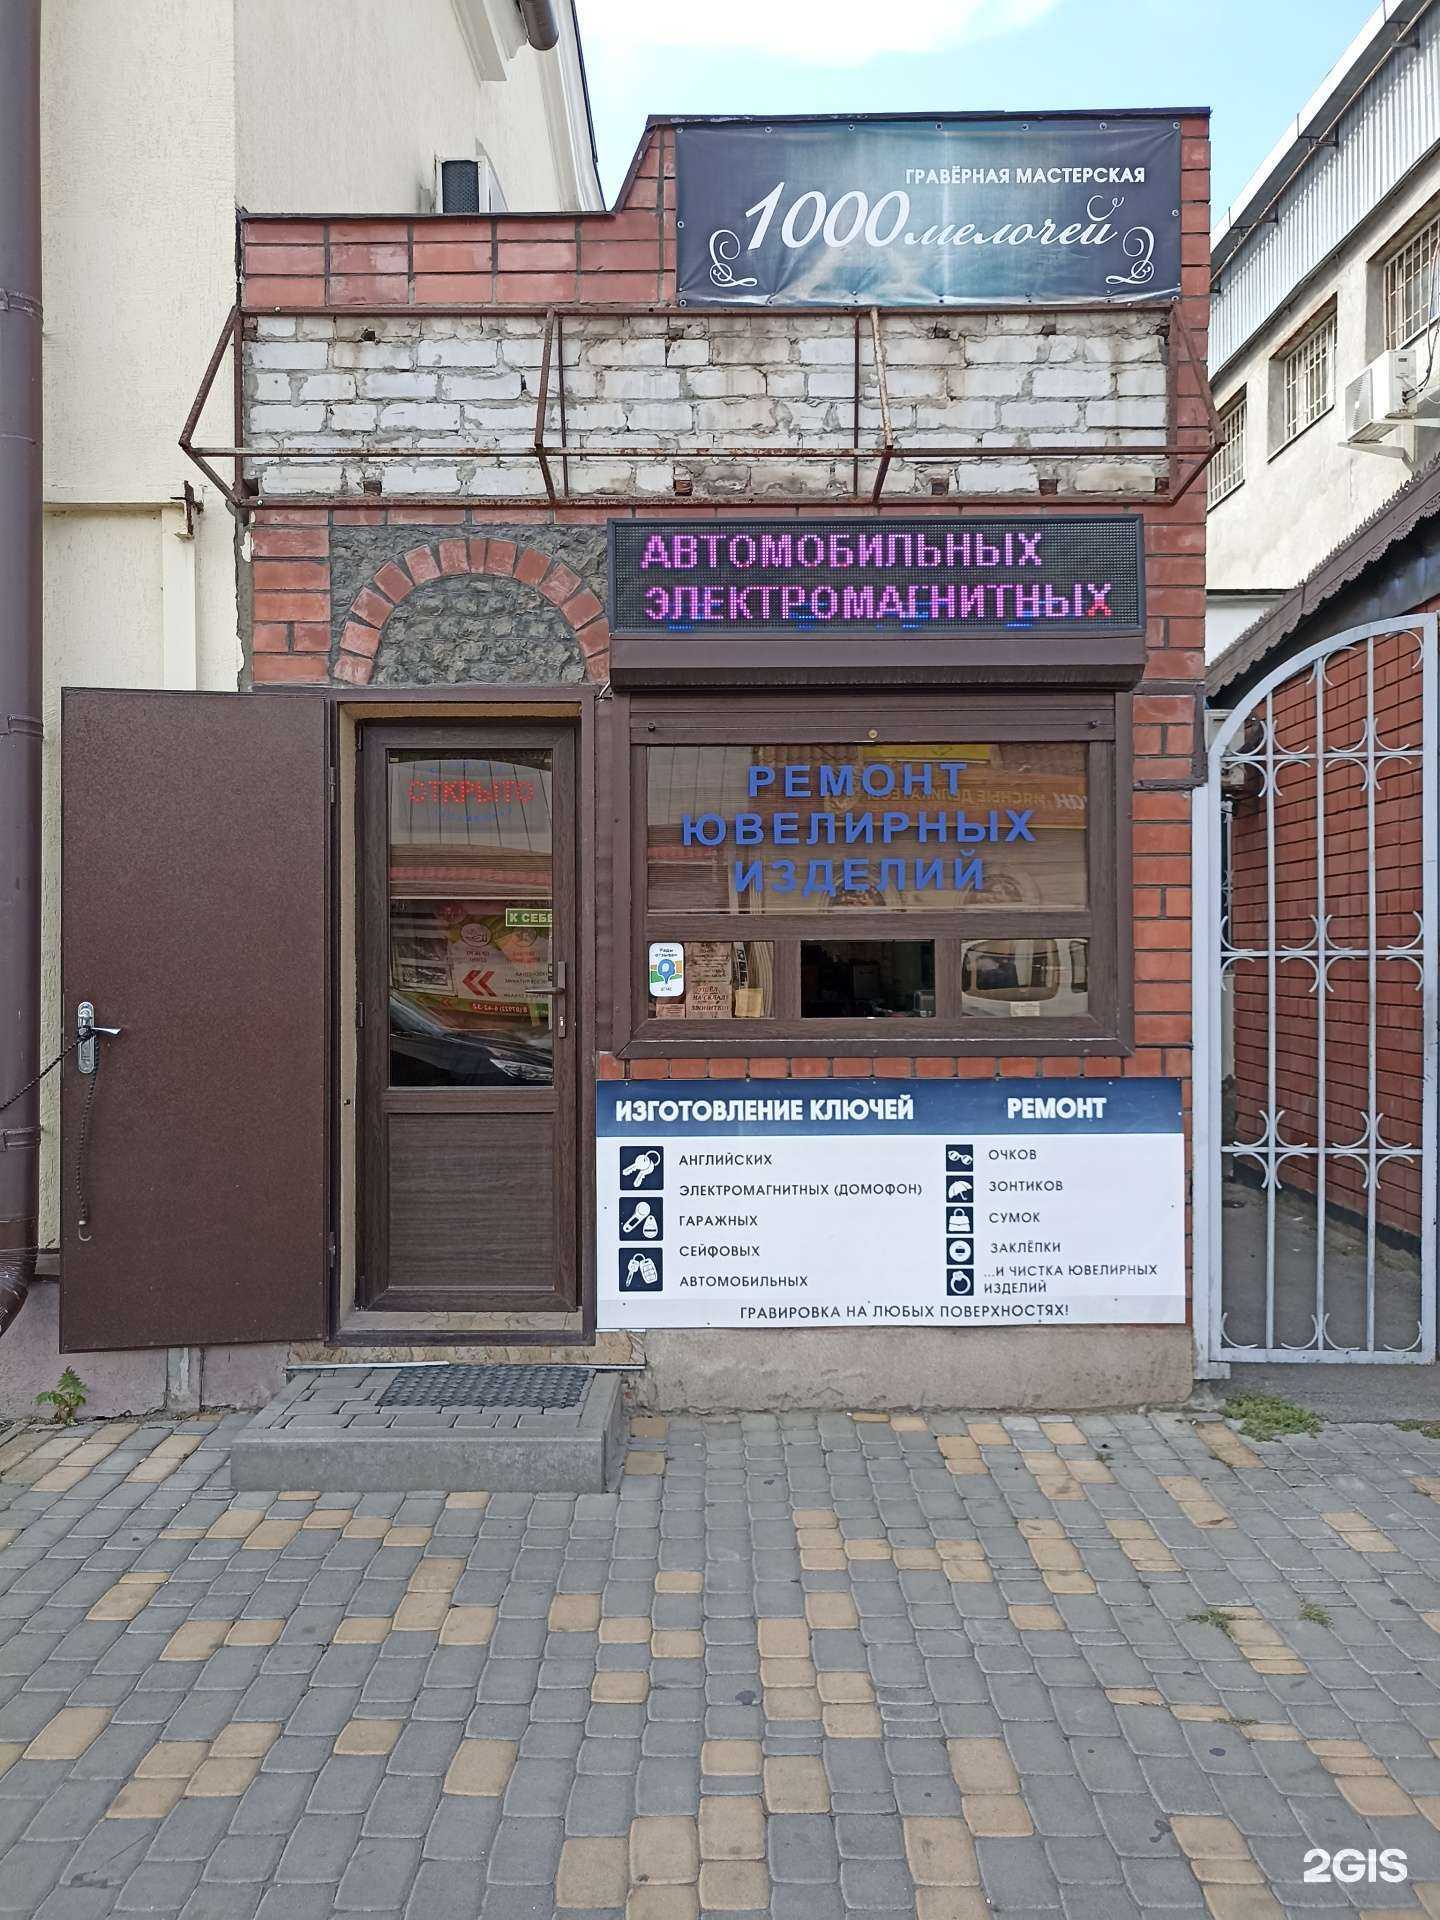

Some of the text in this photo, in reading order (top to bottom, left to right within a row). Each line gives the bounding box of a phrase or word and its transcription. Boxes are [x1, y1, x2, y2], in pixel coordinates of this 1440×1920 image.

[905, 165, 1145, 184] ГРАВЁРНАЯ МАСТЕРСКАЯ
[745, 182, 1125, 250] 1000 мелочей
[639, 532, 1043, 569] АВТОМОБИЛЬНЫХ
[644, 583, 1113, 621] ЭЛЕКТРОМАГНИТНЫХ
[747, 761, 969, 798] РЕМОНТ
[407, 779, 534, 804] ОТКРЫТО
[681, 809, 1037, 847] ЮВЕЛИРНЫХ
[733, 848, 985, 898] ИЗДЕЛИЙ
[509, 913, 518, 923] К
[615, 1095, 914, 1122] ИЗГОТОВЛЕНИЕ КЛЮЧЕЙ
[1007, 1097, 1108, 1119] РЕМОНТ
[679, 1152, 773, 1166] АНГЛИЙСКИХ
[988, 1149, 1037, 1160] ОЧКОВ
[679, 1183, 923, 1197] ЭЛЕКТРОМАГНИТНЫХ (ДОМОФОН)
[988, 1180, 1063, 1192] ЗОНТИКОВ
[679, 1215, 758, 1227] ГАРАЖНЫХ
[988, 1211, 1041, 1224] СУМОК
[679, 1243, 760, 1258] СЕЙФОВЫХ
[990, 1240, 1061, 1253] ЗАКЛЁПКИ
[1009, 1265, 1063, 1277] ЧИСТКА
[1068, 1264, 1158, 1276] ЮВЕЛИРНЫХ
[679, 1275, 808, 1287] АВТОМОБИЛЬНЫХ
[984, 1280, 1047, 1294] ИЗДЕЛИЙ
[740, 1303, 1069, 1319] ГРАВИРОВКА НА ЛЮБЫХ ПОВЕРХНОСТЯХ!
